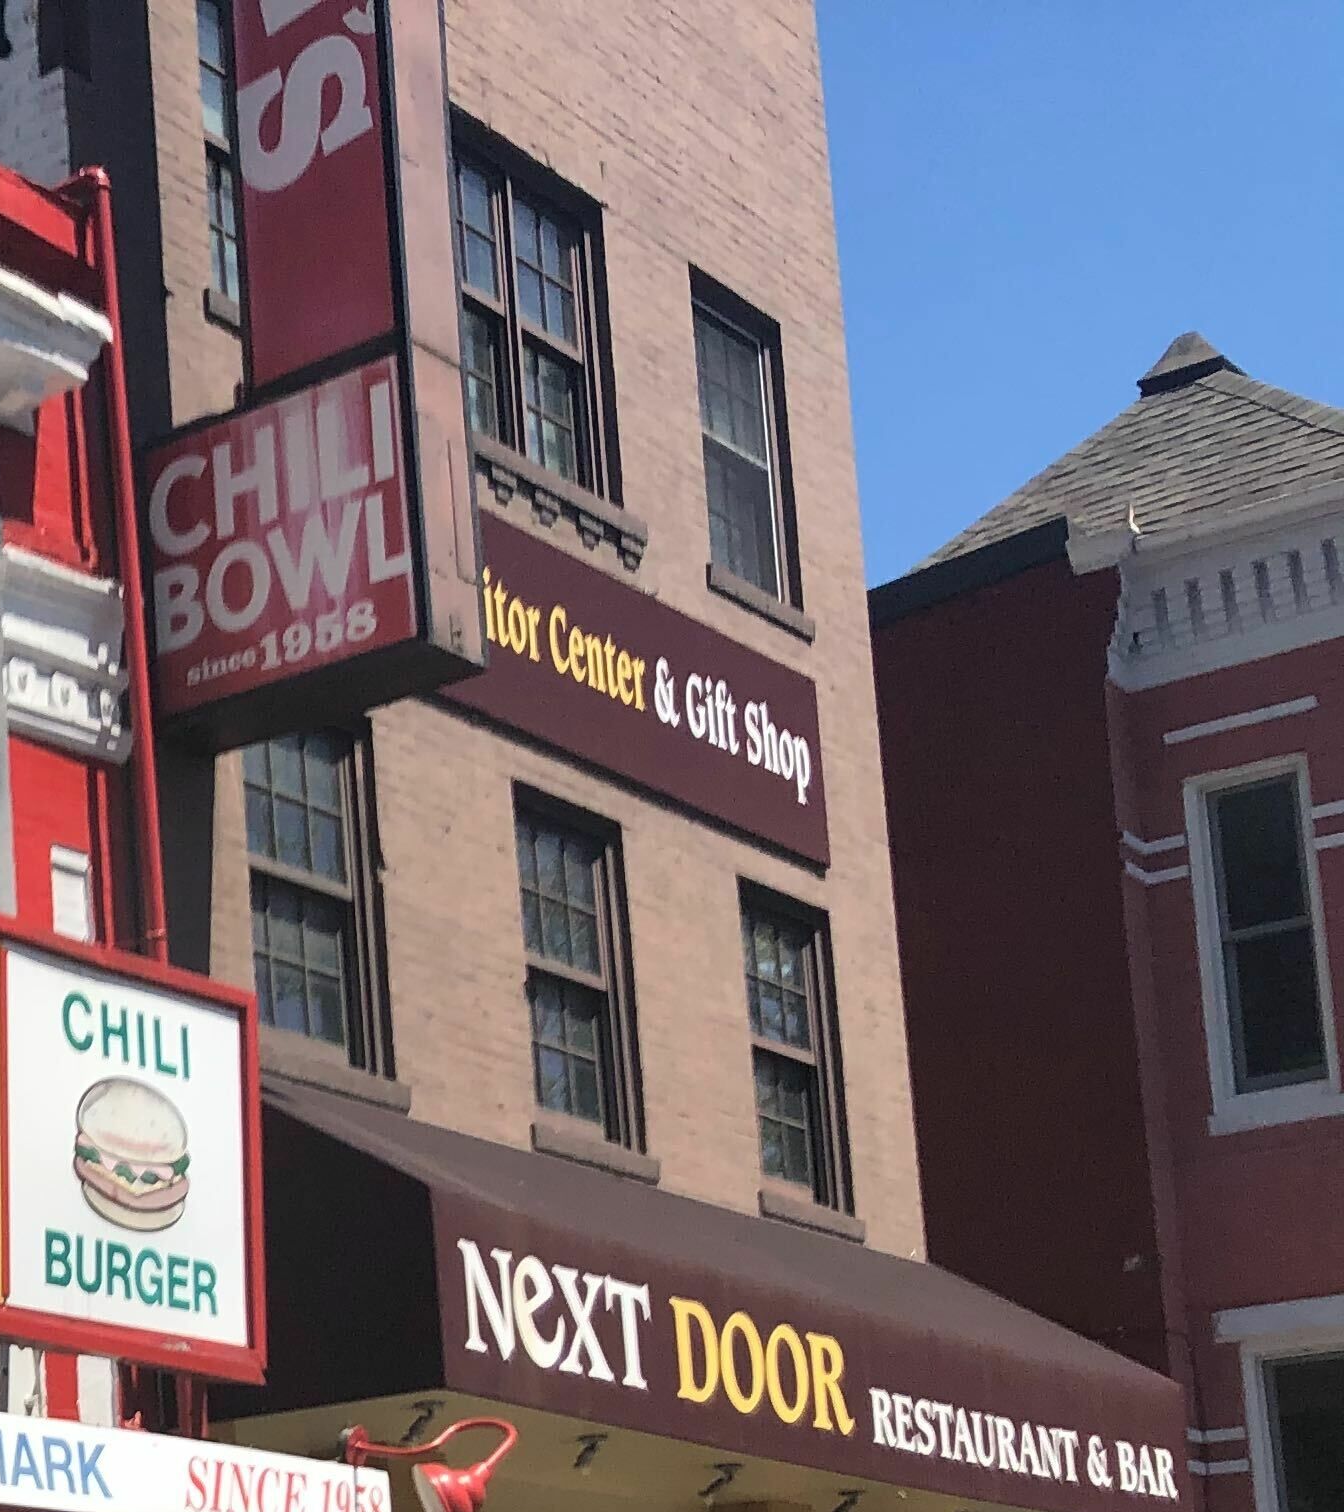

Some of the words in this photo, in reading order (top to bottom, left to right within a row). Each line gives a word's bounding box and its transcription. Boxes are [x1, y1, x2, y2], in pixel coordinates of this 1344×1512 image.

[149, 379, 395, 556] CHILI
[153, 492, 413, 655] BOWL
[185, 647, 256, 688] since
[260, 598, 378, 671] 1958
[482, 565, 541, 663] itor
[549, 603, 647, 713] Center
[653, 655, 679, 728] &
[685, 672, 741, 757] Gift
[744, 700, 811, 806] Shop
[61, 991, 192, 1082] CHILI
[43, 1229, 219, 1317] BURGER
[669, 1297, 856, 1437] DOOR
[868, 1387, 1082, 1484] RESTAURANT
[1085, 1434, 1113, 1489] &
[1115, 1440, 1179, 1500] BAR
